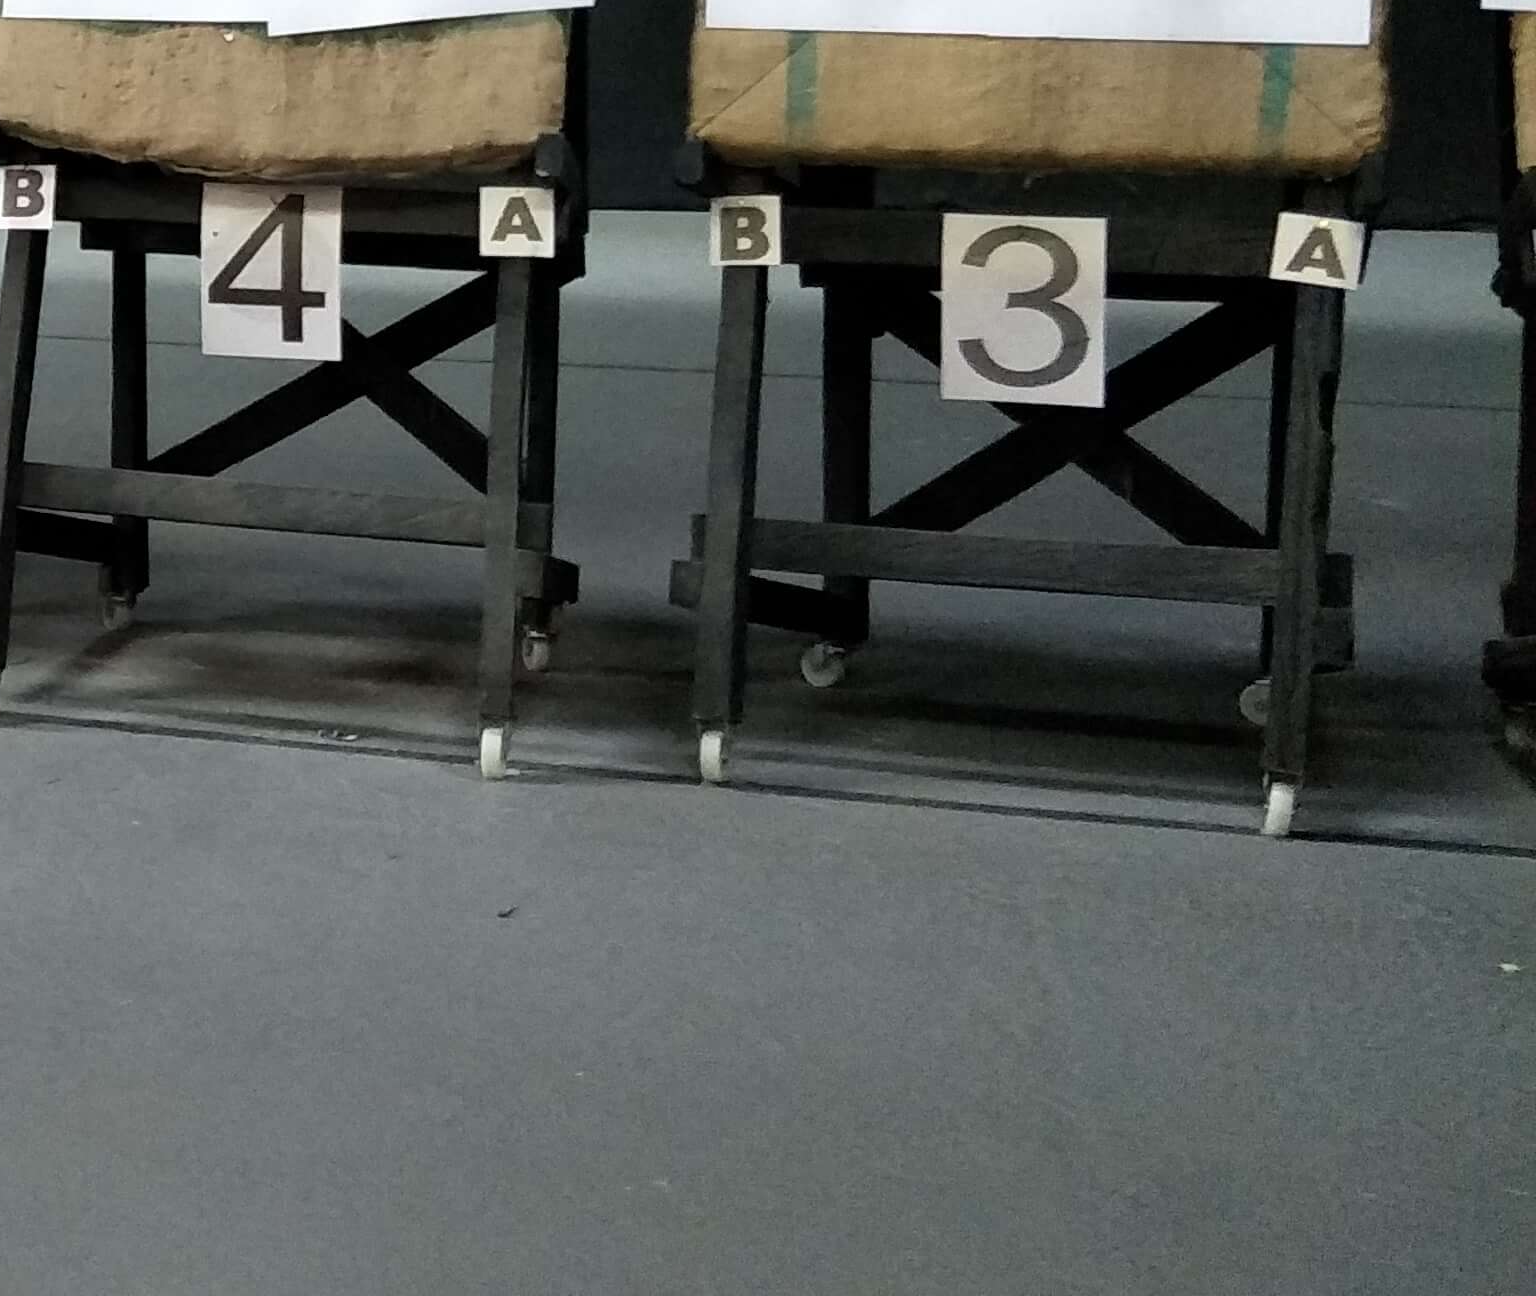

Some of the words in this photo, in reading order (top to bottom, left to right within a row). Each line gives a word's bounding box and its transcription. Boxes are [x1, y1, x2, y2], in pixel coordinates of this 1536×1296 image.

[1, 168, 46, 218] B
[490, 196, 544, 243] A
[718, 205, 773, 262] B
[1283, 225, 1347, 281] A
[208, 193, 326, 343] 4
[957, 224, 1090, 388] 3
